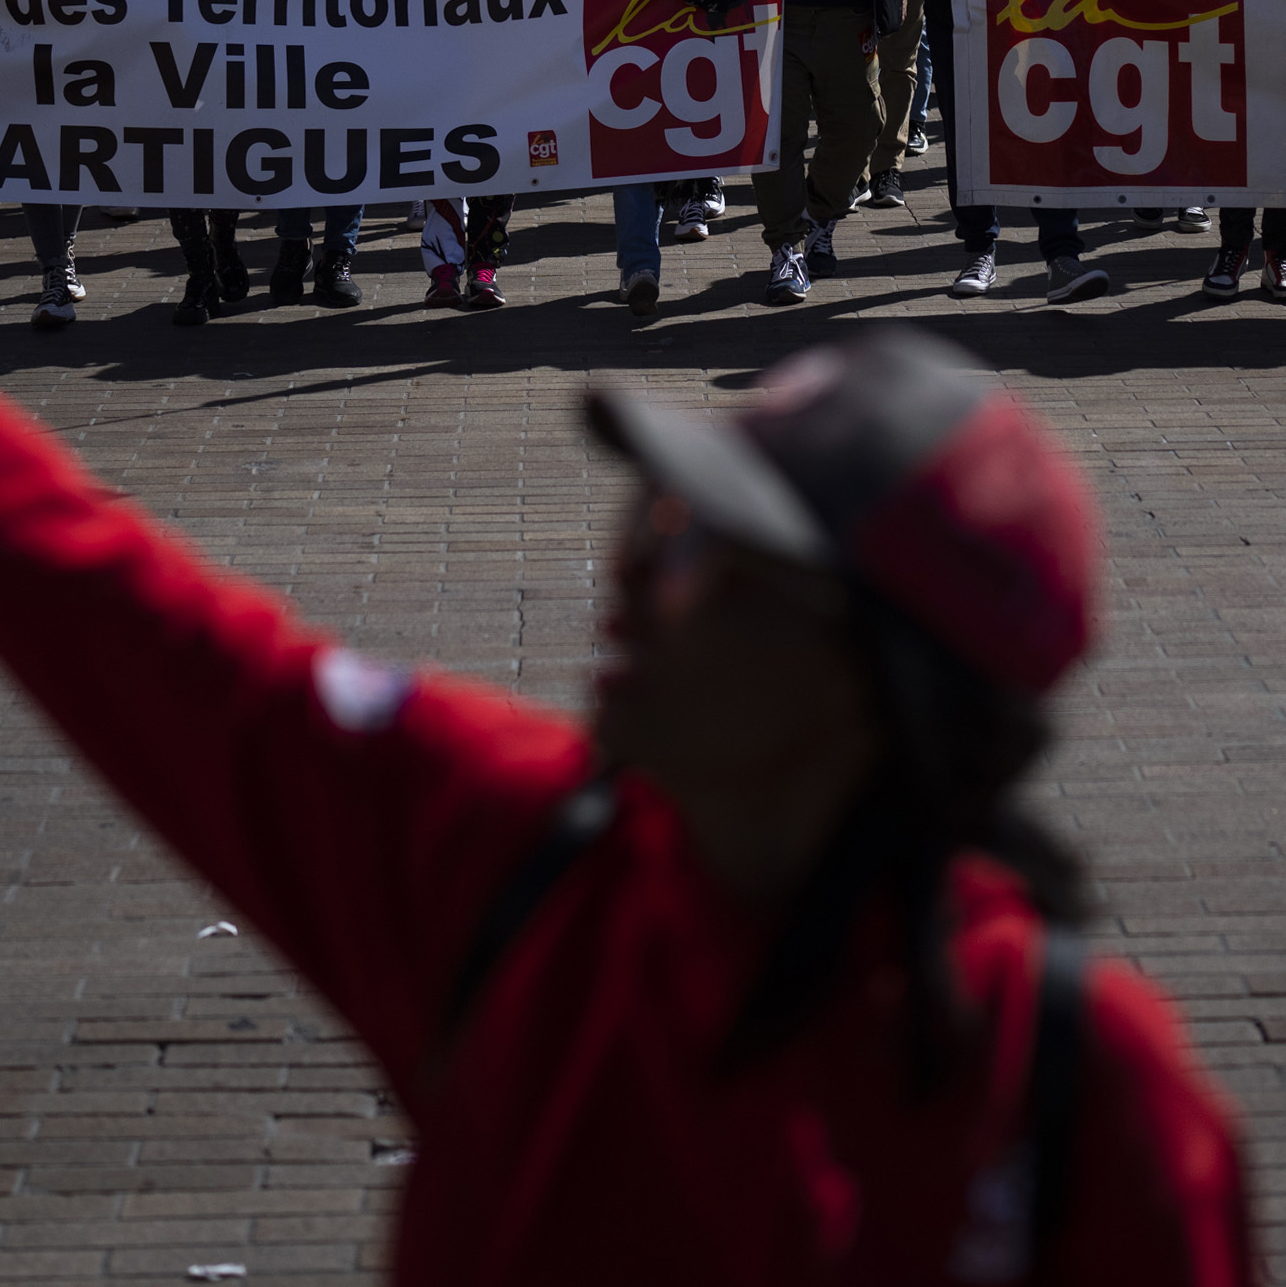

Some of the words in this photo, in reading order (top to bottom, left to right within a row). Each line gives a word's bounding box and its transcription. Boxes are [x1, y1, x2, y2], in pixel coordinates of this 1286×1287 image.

[32, 43, 116, 108] la
[149, 40, 371, 111] Ville
[587, 2, 781, 158] cgt
[996, 14, 1238, 176] cgt
[529, 139, 557, 159] cgt
